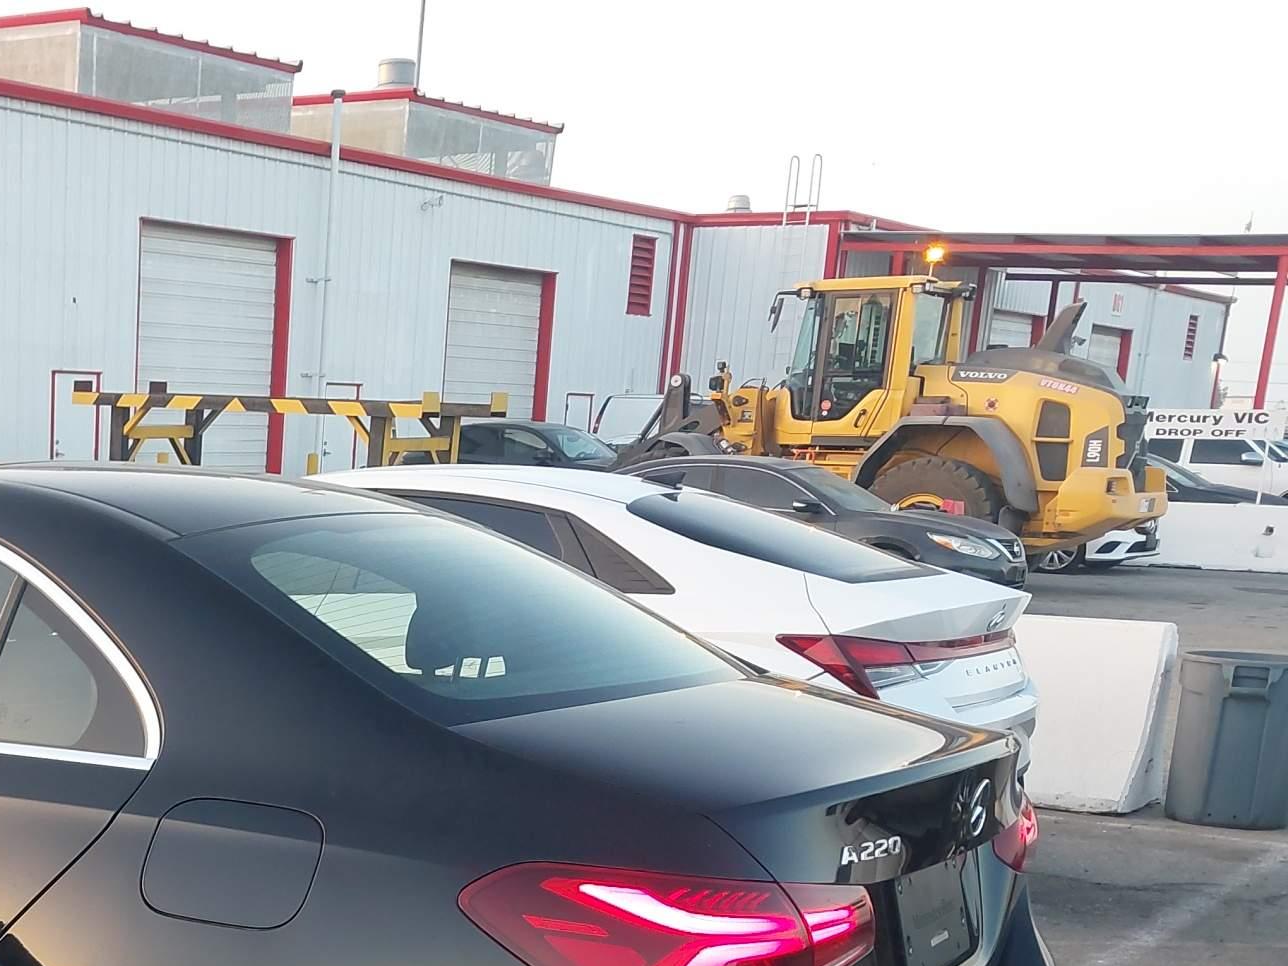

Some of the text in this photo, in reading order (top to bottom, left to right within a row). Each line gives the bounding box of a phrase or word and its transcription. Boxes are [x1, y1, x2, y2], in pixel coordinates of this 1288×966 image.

[958, 370, 1008, 379] VOLVO
[1234, 412, 1271, 424] VIC
[1155, 428, 1248, 437] DROP OFF
[1086, 439, 1103, 463] L90H
